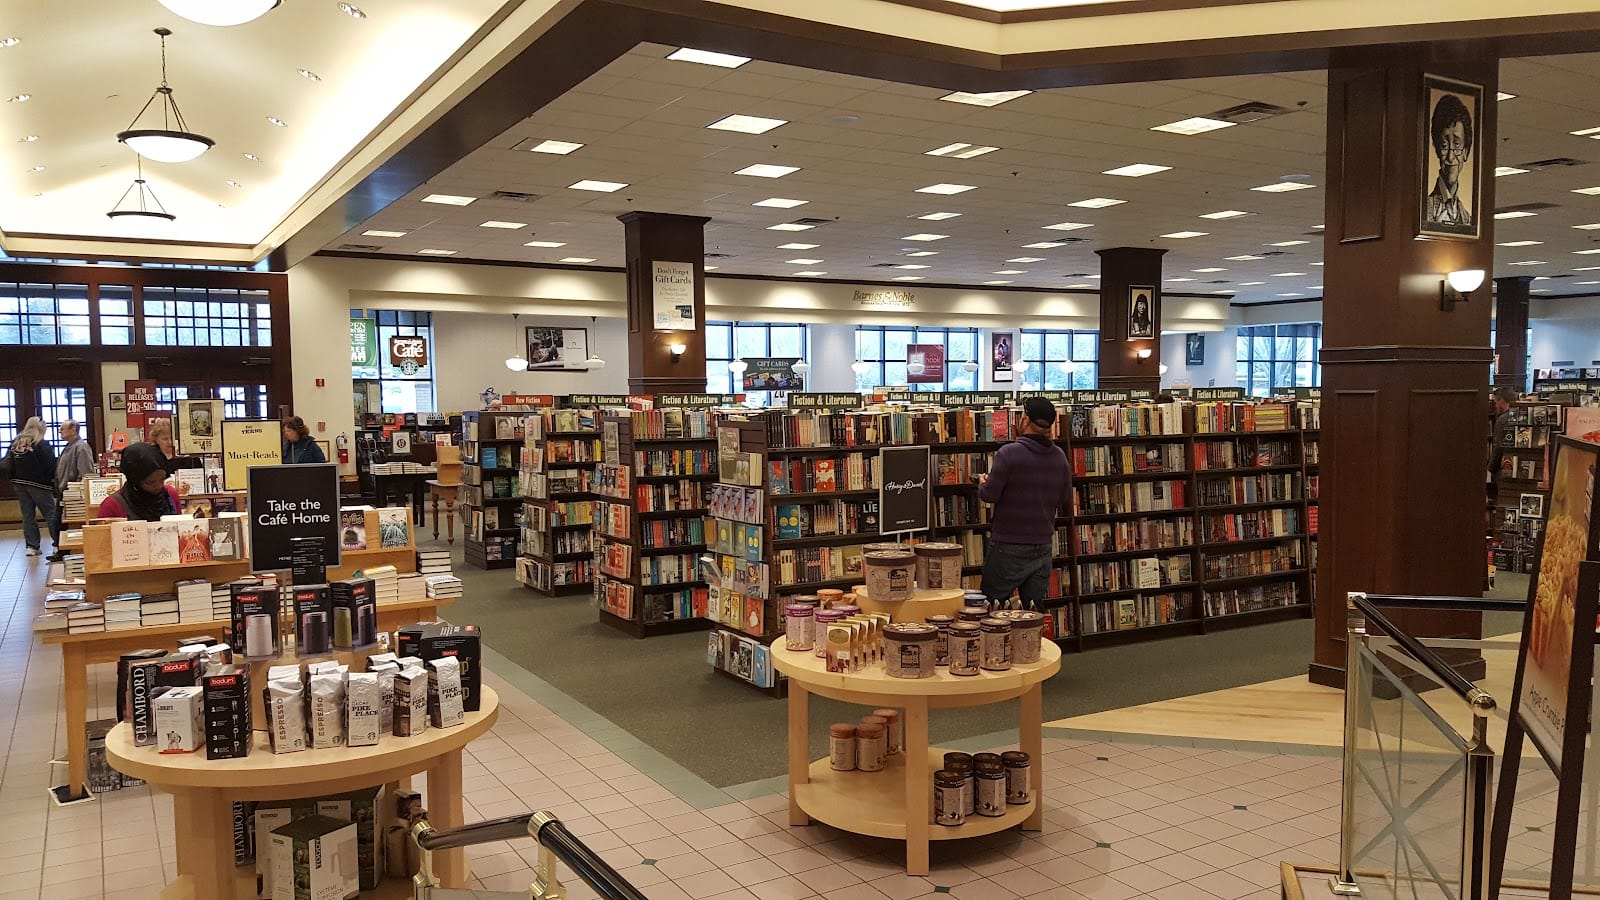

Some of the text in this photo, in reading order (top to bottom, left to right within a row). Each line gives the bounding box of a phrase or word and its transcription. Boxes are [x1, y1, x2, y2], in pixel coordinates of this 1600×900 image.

[655, 275, 691, 284] Gift Cards
[853, 290, 883, 301] Barnes
[893, 291, 915, 302] Noble
[393, 343, 424, 358] Café
[572, 395, 590, 403] Fiction
[597, 395, 623, 404] Literature
[662, 395, 682, 404] Fiction
[690, 395, 718, 404] Literature
[793, 394, 857, 405] Fiction & Literature
[913, 393, 929, 401] Fiction
[944, 394, 963, 405] Fiction
[964, 395, 971, 404] &
[972, 394, 999, 405] Literature
[1078, 392, 1127, 401] Fiction & Literature
[1196, 390, 1211, 399] Fiction
[1217, 390, 1239, 399] Literature
[228, 451, 279, 460] Must-Reads
[266, 498, 321, 512] Take the
[862, 503, 879, 513] LIE
[258, 513, 288, 526] Café
[292, 512, 331, 525] Home
[164, 663, 189, 671] bodum
[211, 677, 235, 686] bodum
[133, 667, 148, 743] CHAMBORD
[277, 698, 287, 740] ESPRESSO
[316, 697, 326, 737] ESPRESSO
